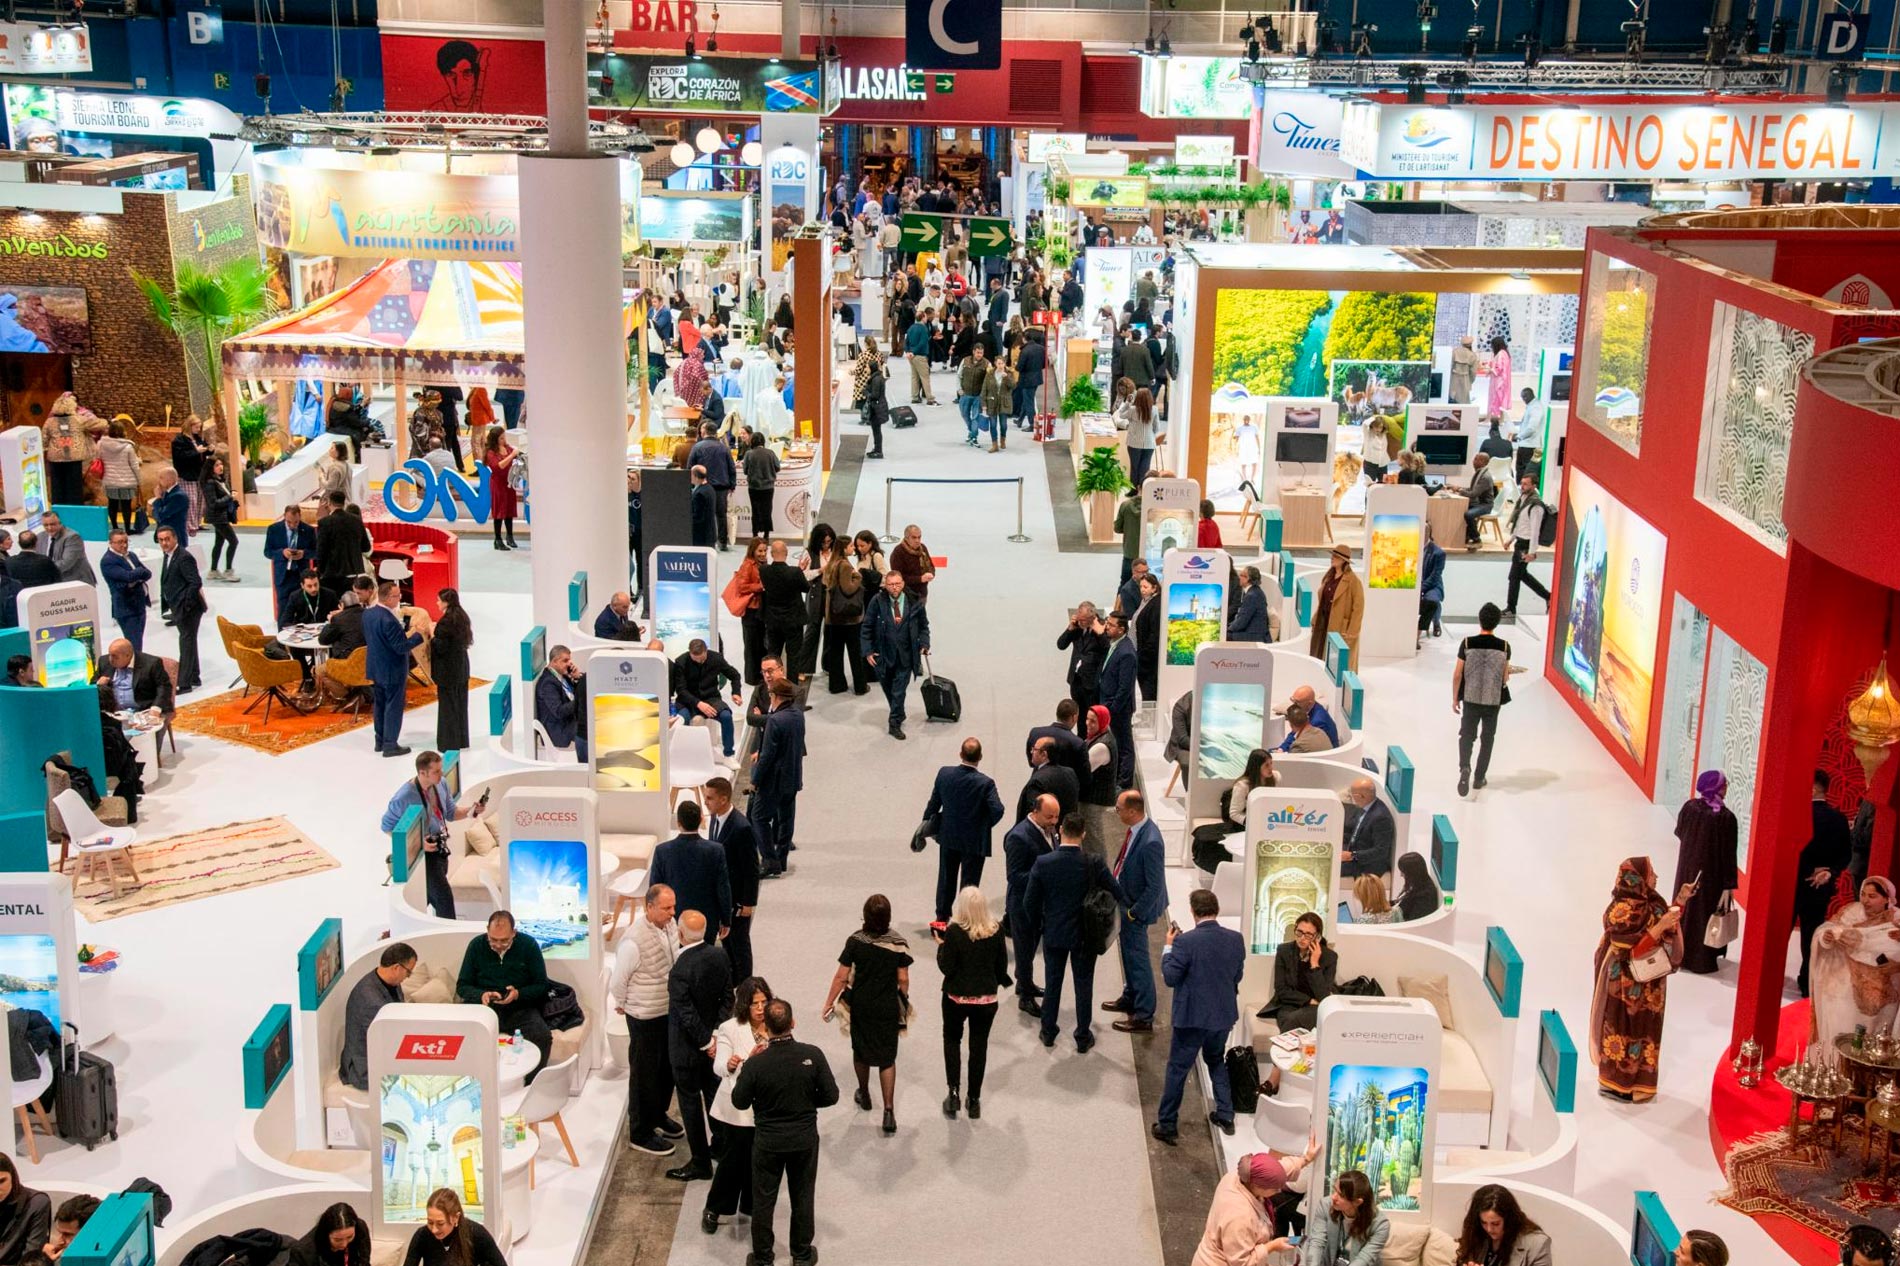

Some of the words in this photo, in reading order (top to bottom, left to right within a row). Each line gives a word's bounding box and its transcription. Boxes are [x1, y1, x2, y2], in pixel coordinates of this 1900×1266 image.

[631, 0, 699, 32] BAR
[187, 11, 212, 45] B
[928, 0, 979, 55] C
[1827, 20, 1858, 54] D
[650, 67, 685, 75] EXPLORA
[648, 76, 688, 99] RDC
[689, 77, 740, 90] CORAZÓN
[689, 90, 704, 100] DE
[705, 88, 742, 102] ÁFRICA
[72, 99, 105, 113] SIERRA
[107, 100, 138, 115] LEONE
[73, 112, 115, 126] TOURISM
[117, 114, 150, 128] BOARD
[1272, 111, 1341, 152] Túnez
[1488, 114, 1664, 171] DESTINO
[1677, 113, 1862, 171] SENEGAL
[771, 160, 806, 180] RDC
[354, 235, 412, 249] NATIONAL
[416, 237, 469, 250] TOURIST
[472, 239, 514, 251] OFFICE
[1165, 488, 1192, 497] PURE
[50, 598, 76, 607] AGADIR
[40, 608, 64, 618] SOUSS
[64, 604, 88, 613] MASSA
[534, 811, 578, 822] ACCESS
[1267, 804, 1329, 827] alizés
[411, 1039, 448, 1055] kti
